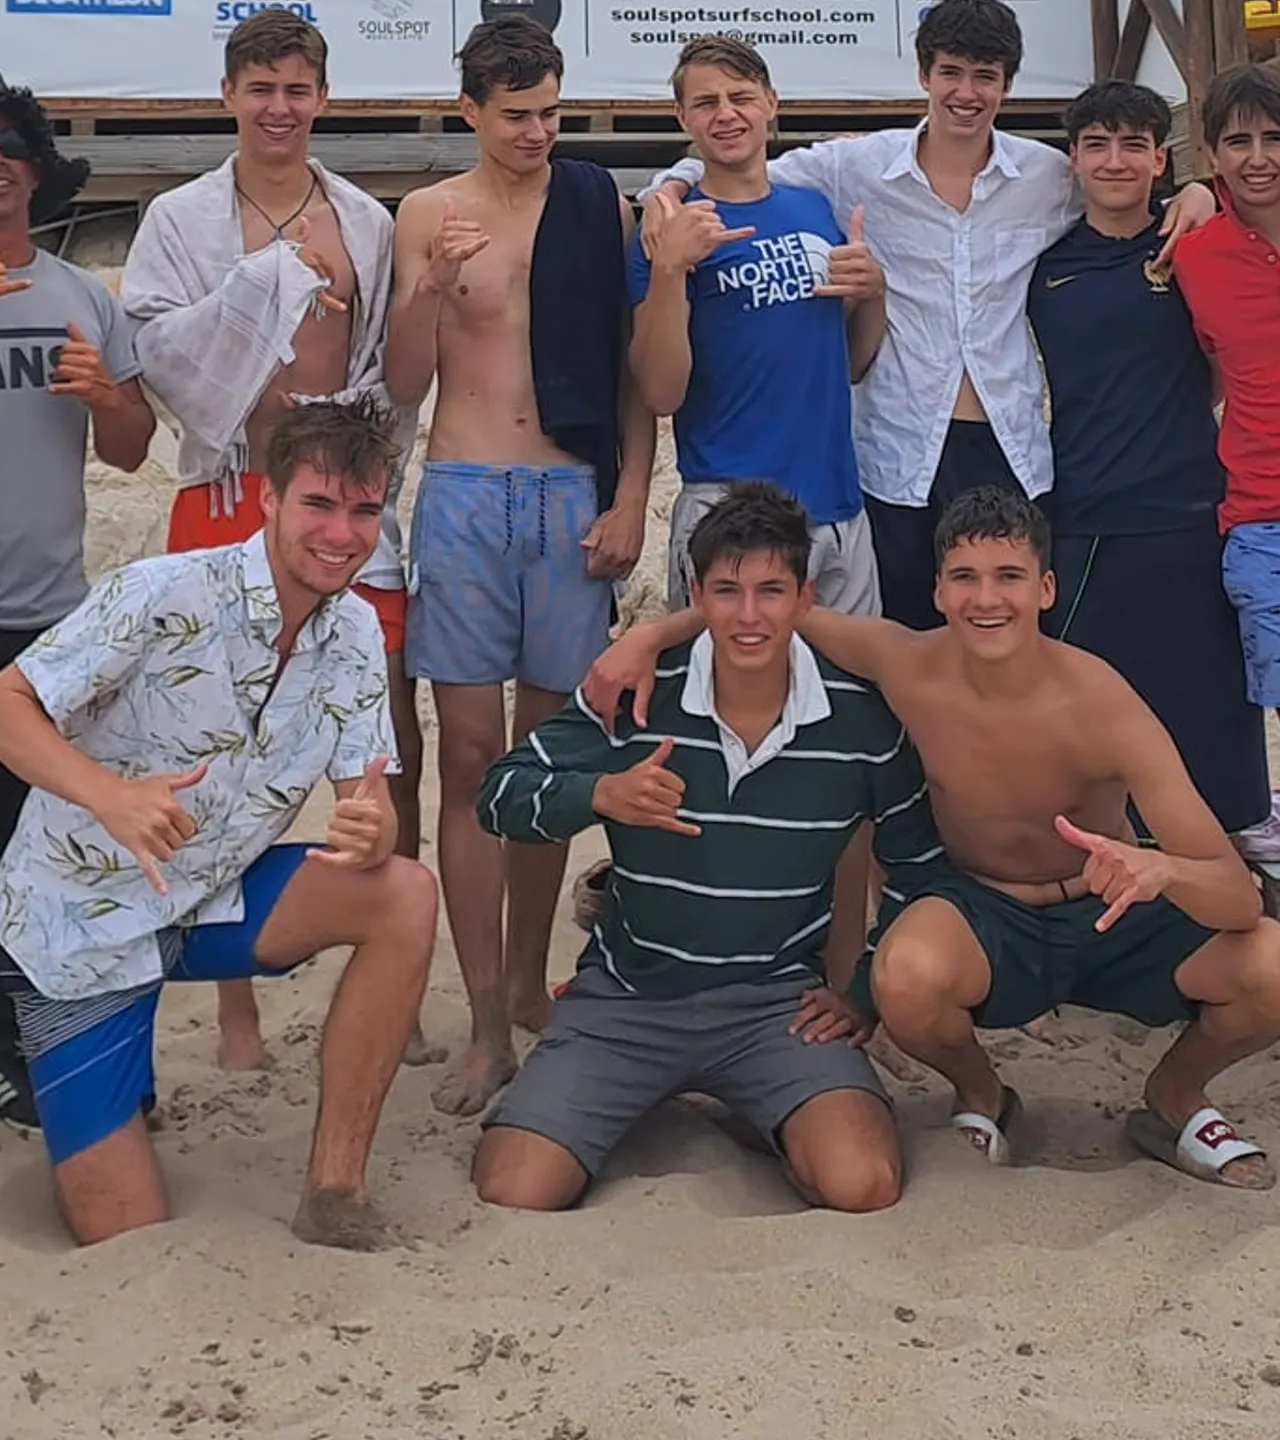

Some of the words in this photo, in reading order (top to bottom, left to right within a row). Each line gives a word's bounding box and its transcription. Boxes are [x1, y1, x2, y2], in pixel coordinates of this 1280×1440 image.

[357, 20, 431, 35] SOULSPOT
[610, 6, 876, 25] soulspotsurfschool.com
[752, 233, 803, 260] THE
[716, 252, 810, 293] NORTH
[752, 274, 814, 308] FACE
